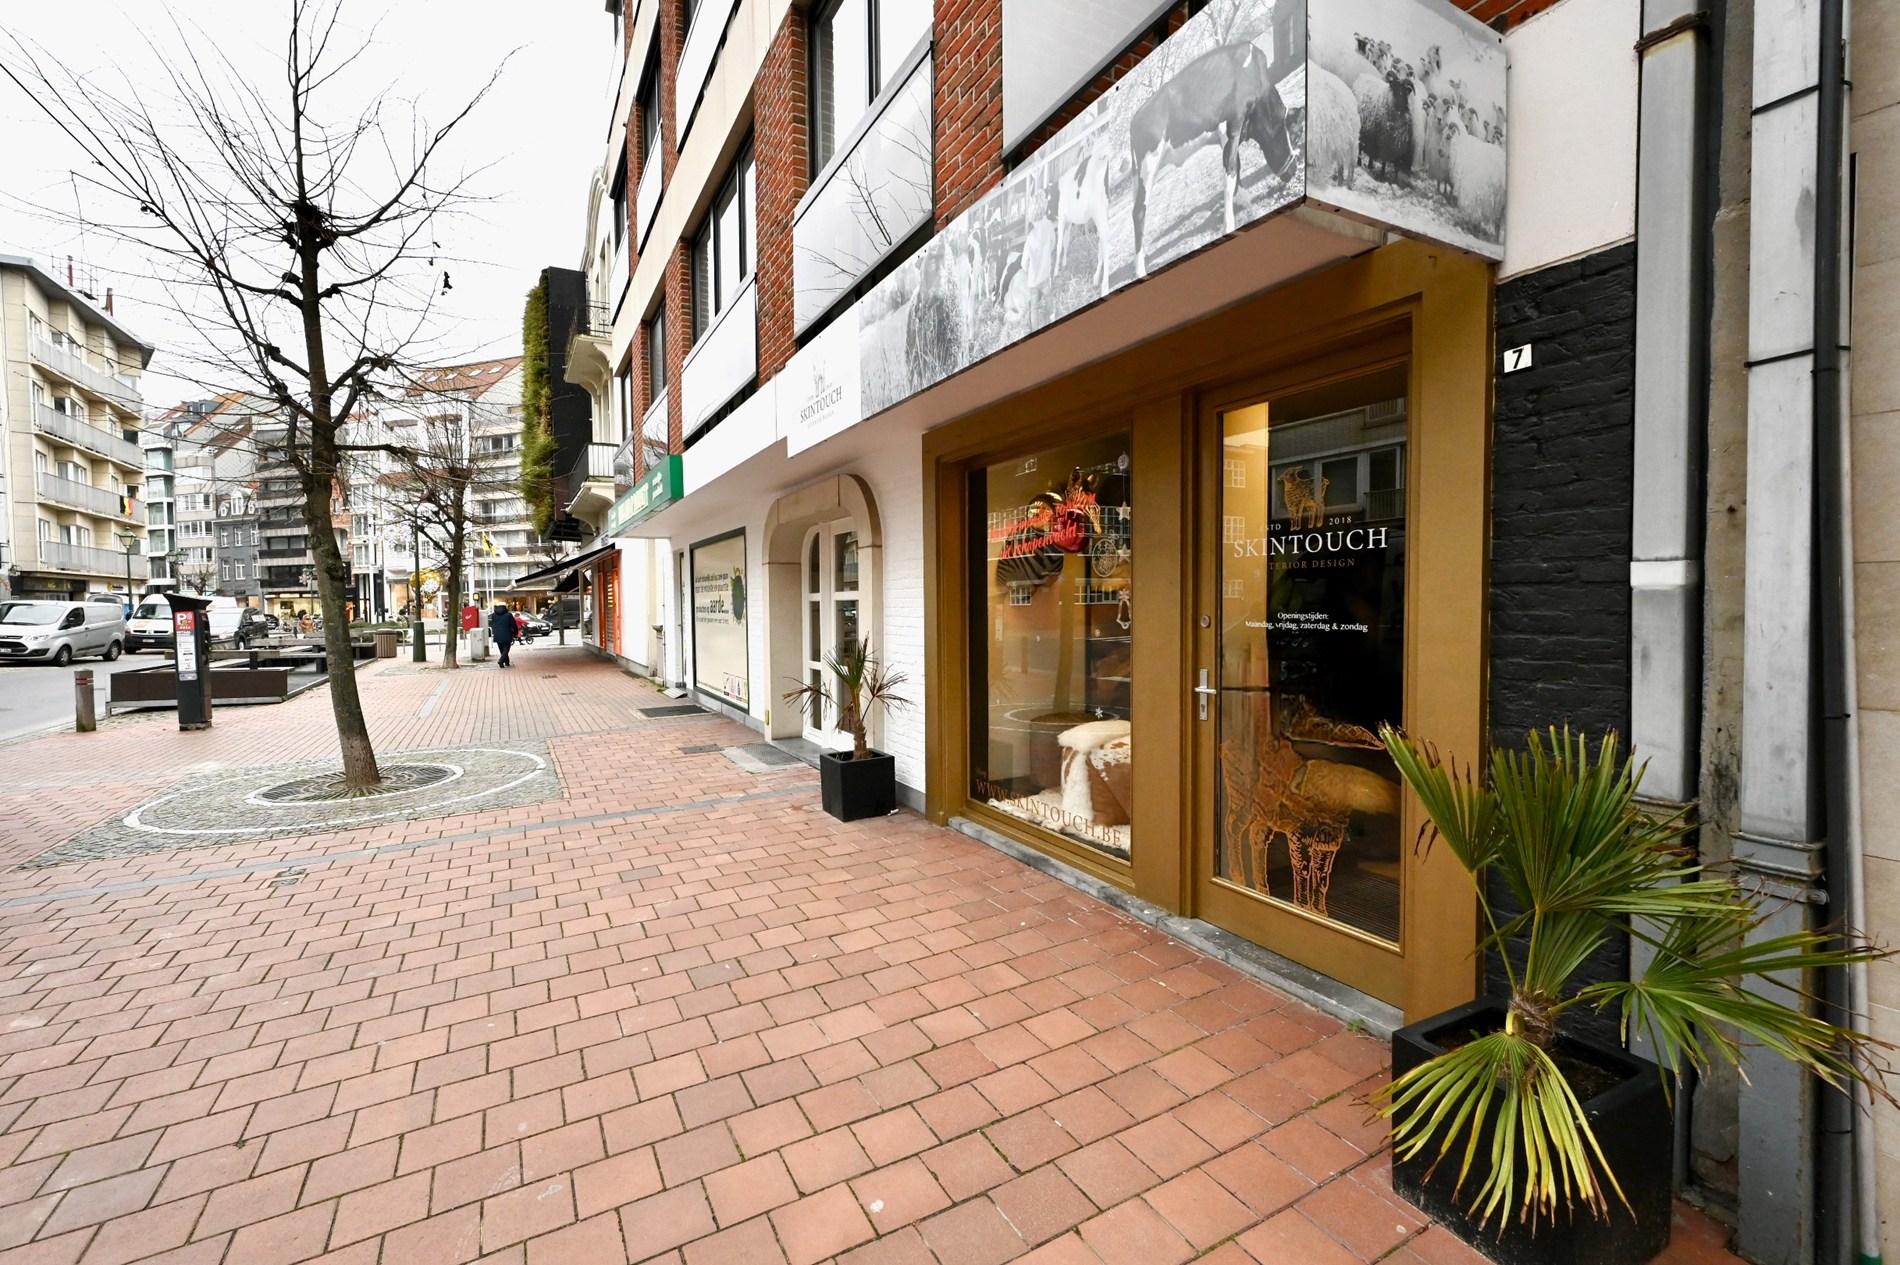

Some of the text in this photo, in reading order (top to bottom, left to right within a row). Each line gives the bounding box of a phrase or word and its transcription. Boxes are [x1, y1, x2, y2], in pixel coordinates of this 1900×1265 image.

[1512, 347, 1525, 369] 7
[800, 386, 843, 424] SKINTOUCH
[1329, 516, 1352, 526] 2018
[1233, 527, 1389, 558] SKINTOUCH
[1269, 558, 1356, 571] TERIOR DESIGN
[1277, 611, 1330, 621] Openingstijden:
[1245, 620, 1369, 633] Maandag, vrijdag, zaterdag & zondag
[976, 779, 1122, 847] WWW.SKINTOUCH.BE
